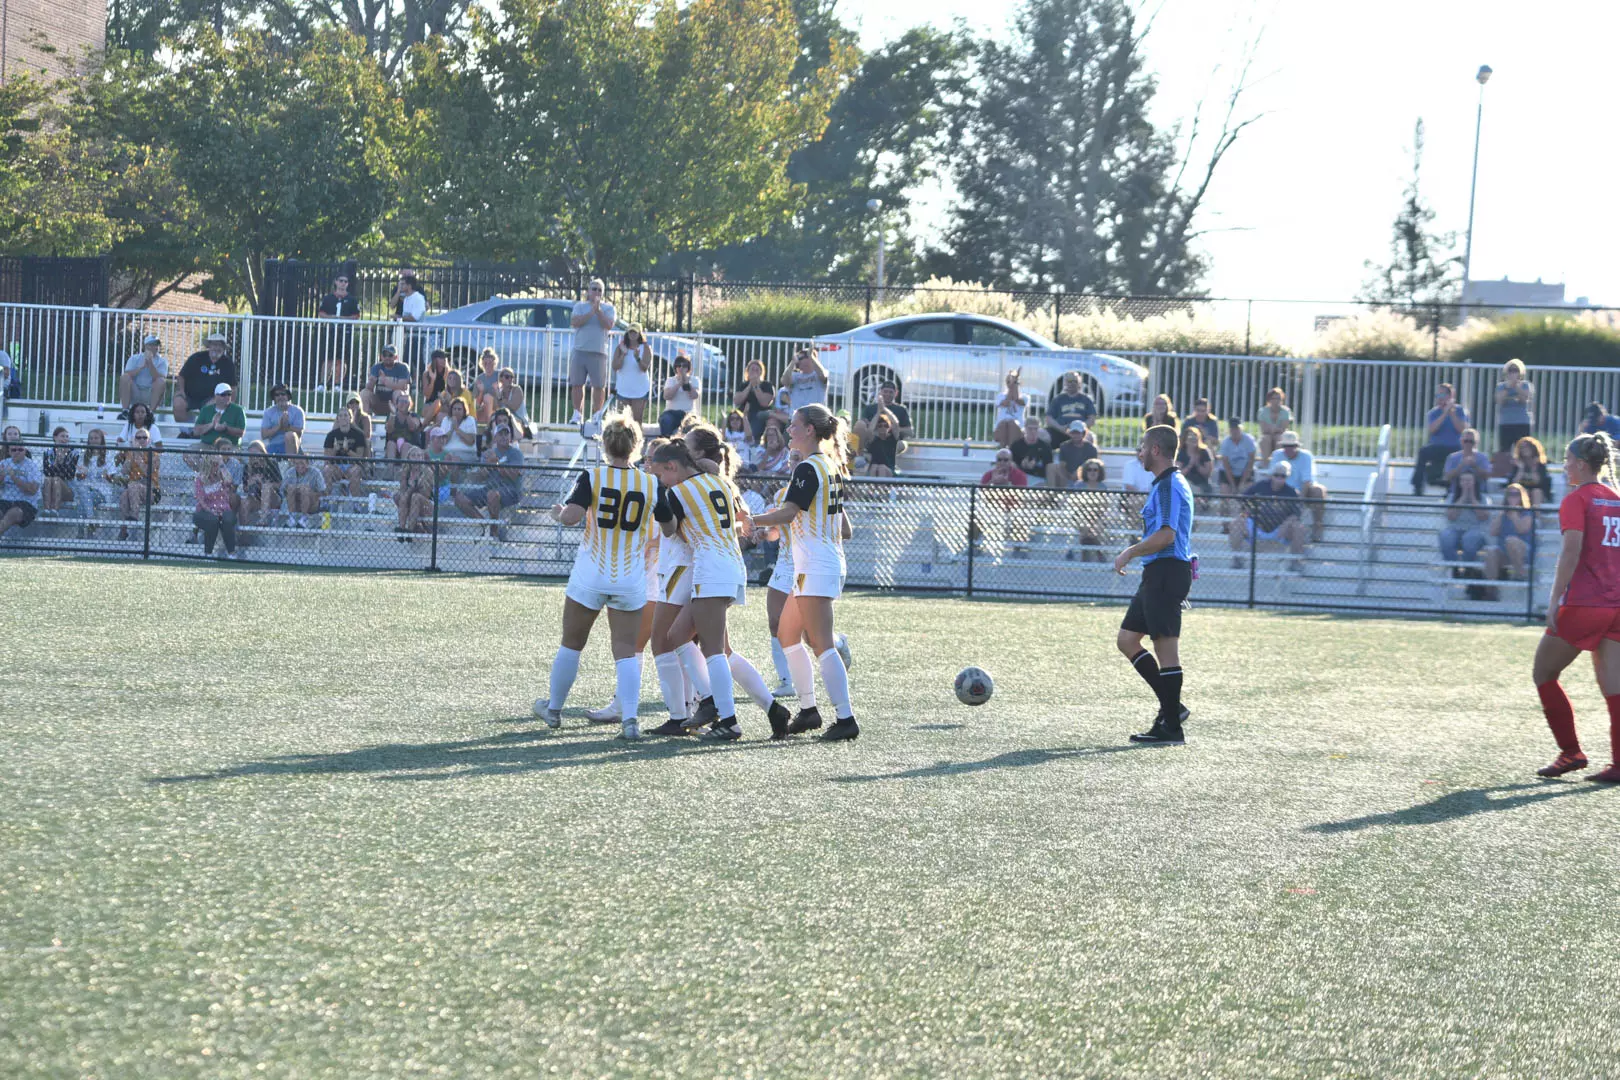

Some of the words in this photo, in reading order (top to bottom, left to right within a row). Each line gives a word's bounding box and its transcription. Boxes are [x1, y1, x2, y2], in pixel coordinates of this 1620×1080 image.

[597, 486, 646, 532] 30
[709, 490, 731, 529] 9
[1600, 515, 1620, 547] 23
